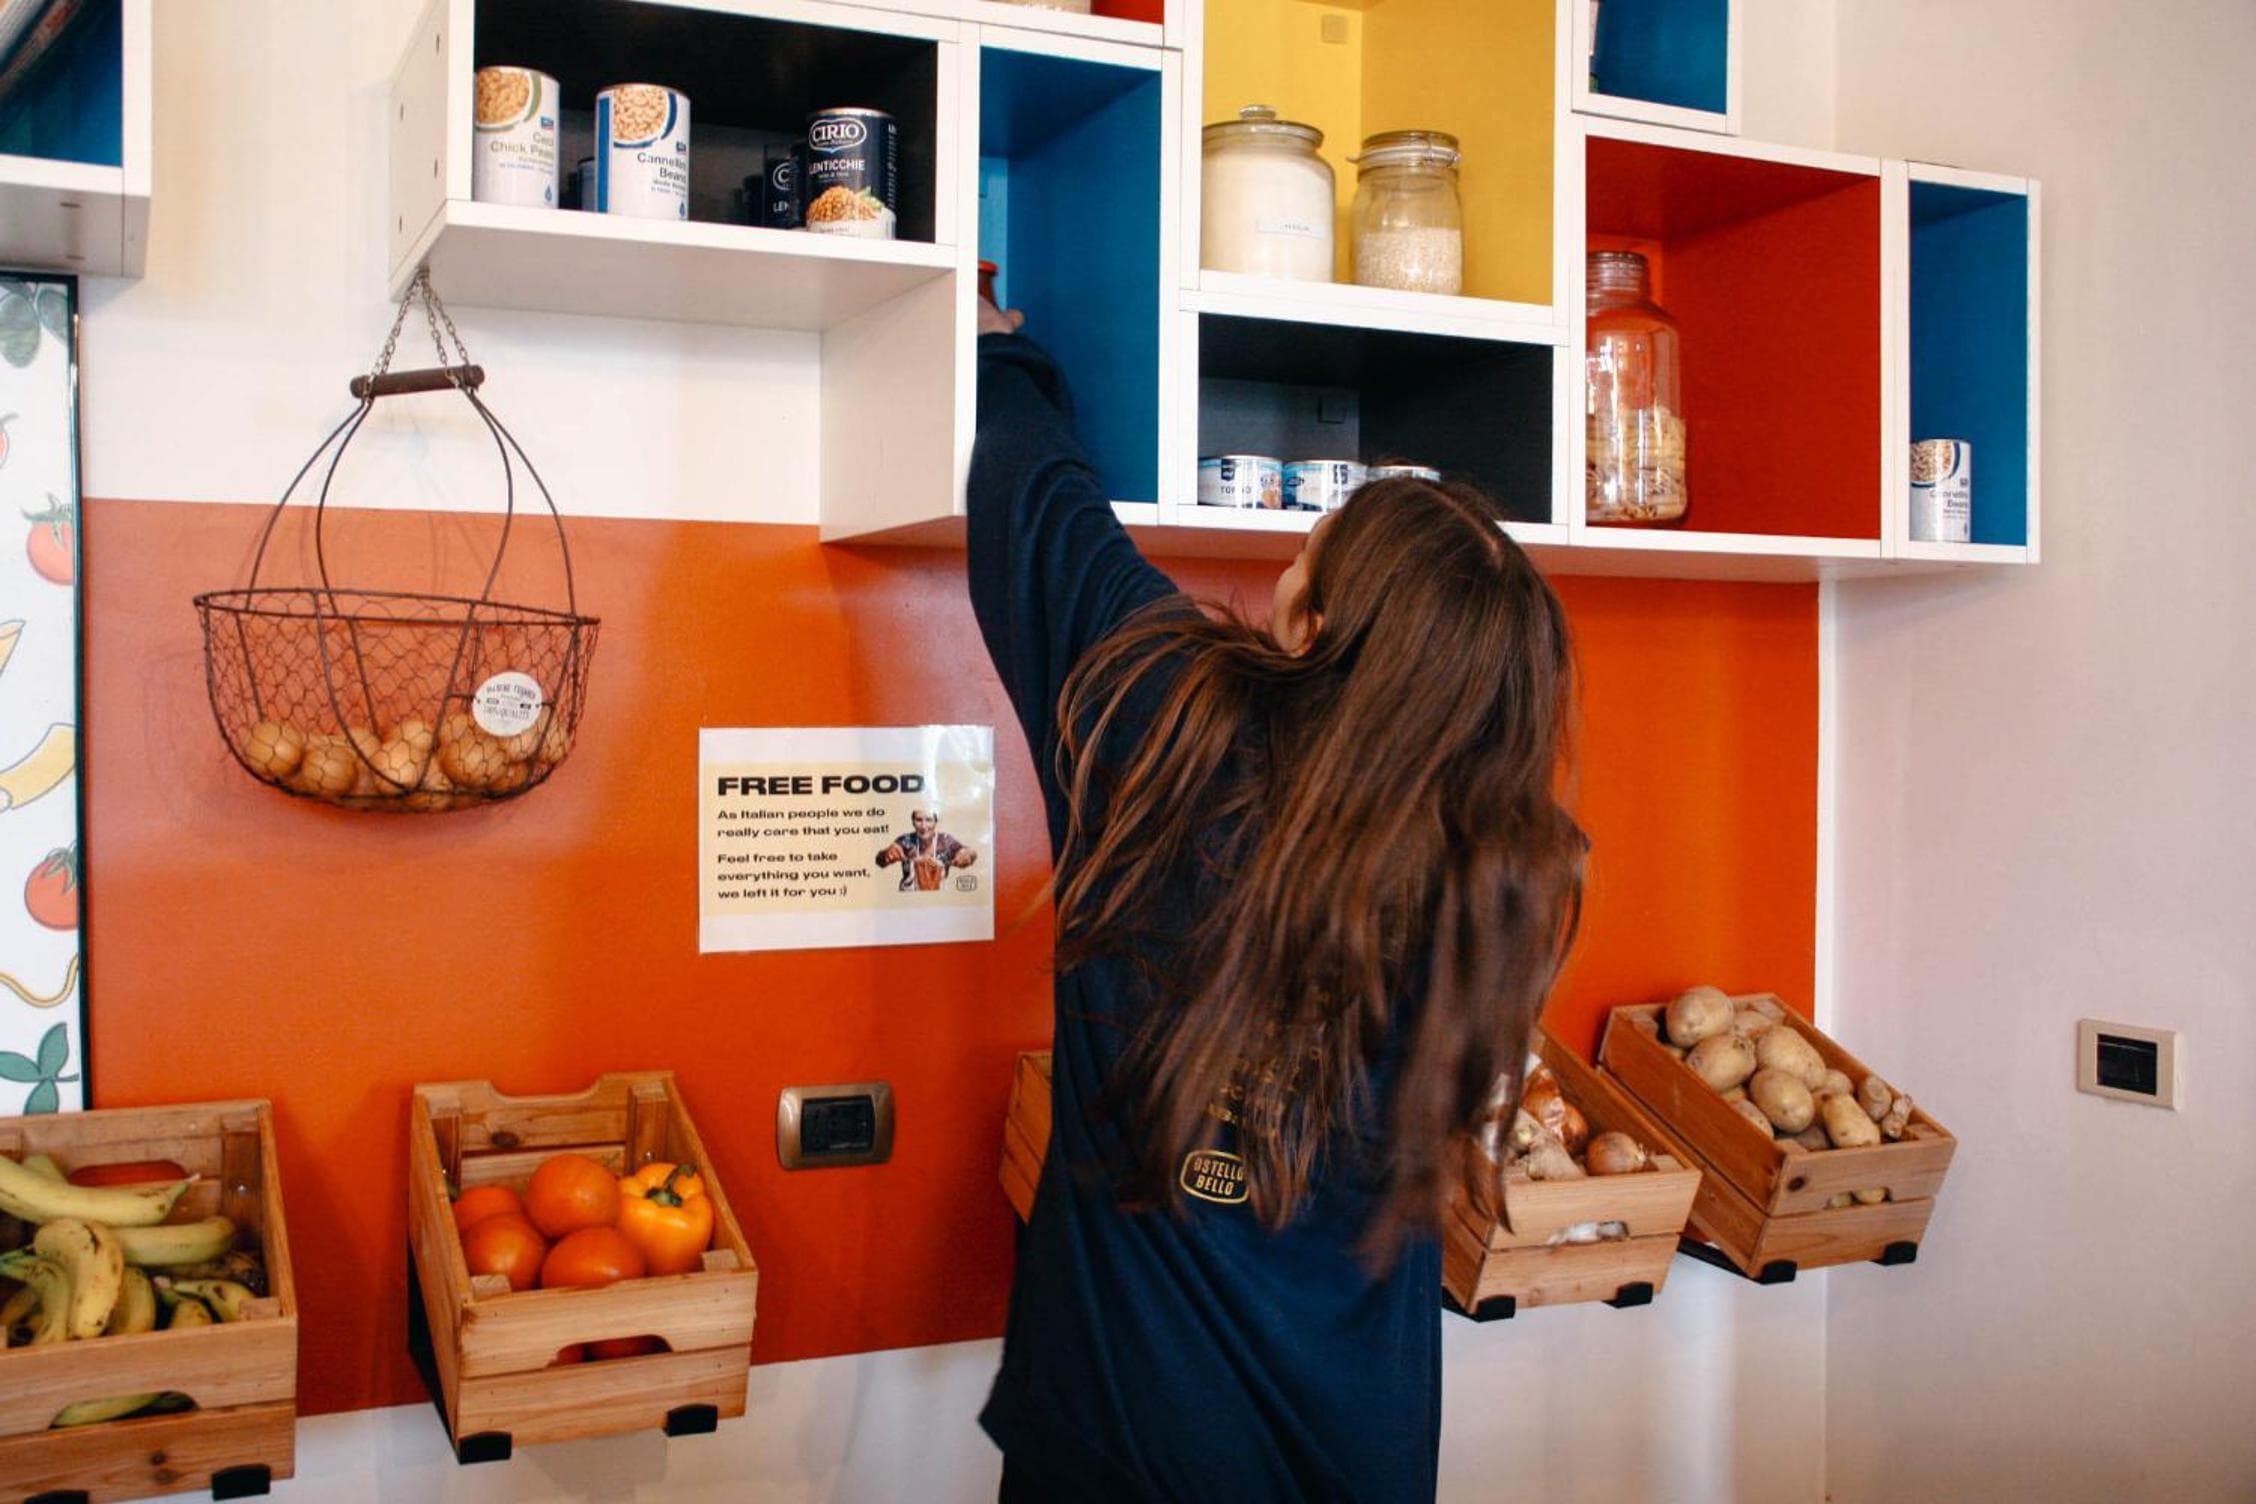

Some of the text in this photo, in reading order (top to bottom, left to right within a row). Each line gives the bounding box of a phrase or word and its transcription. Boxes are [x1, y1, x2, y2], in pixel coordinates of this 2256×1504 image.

[812, 123, 860, 142] CIRIO
[490, 140, 525, 153] Chick
[808, 159, 866, 175] LENTICCHIE
[717, 774, 925, 796] FREE FOOD
[718, 810, 738, 820] As
[740, 809, 785, 820] Italian
[788, 808, 839, 820] people
[866, 807, 885, 817] do
[717, 824, 889, 838] really care that you eat!
[717, 851, 838, 864] Feel free to take
[717, 870, 799, 882] everything
[802, 871, 829, 881] you
[717, 890, 740, 899] we
[743, 888, 767, 898] left
[770, 888, 779, 898] it
[783, 887, 806, 897] for
[810, 888, 837, 898] you
[1193, 1157, 1244, 1181] OSTELLO
[1195, 1174, 1235, 1197] BELLO
